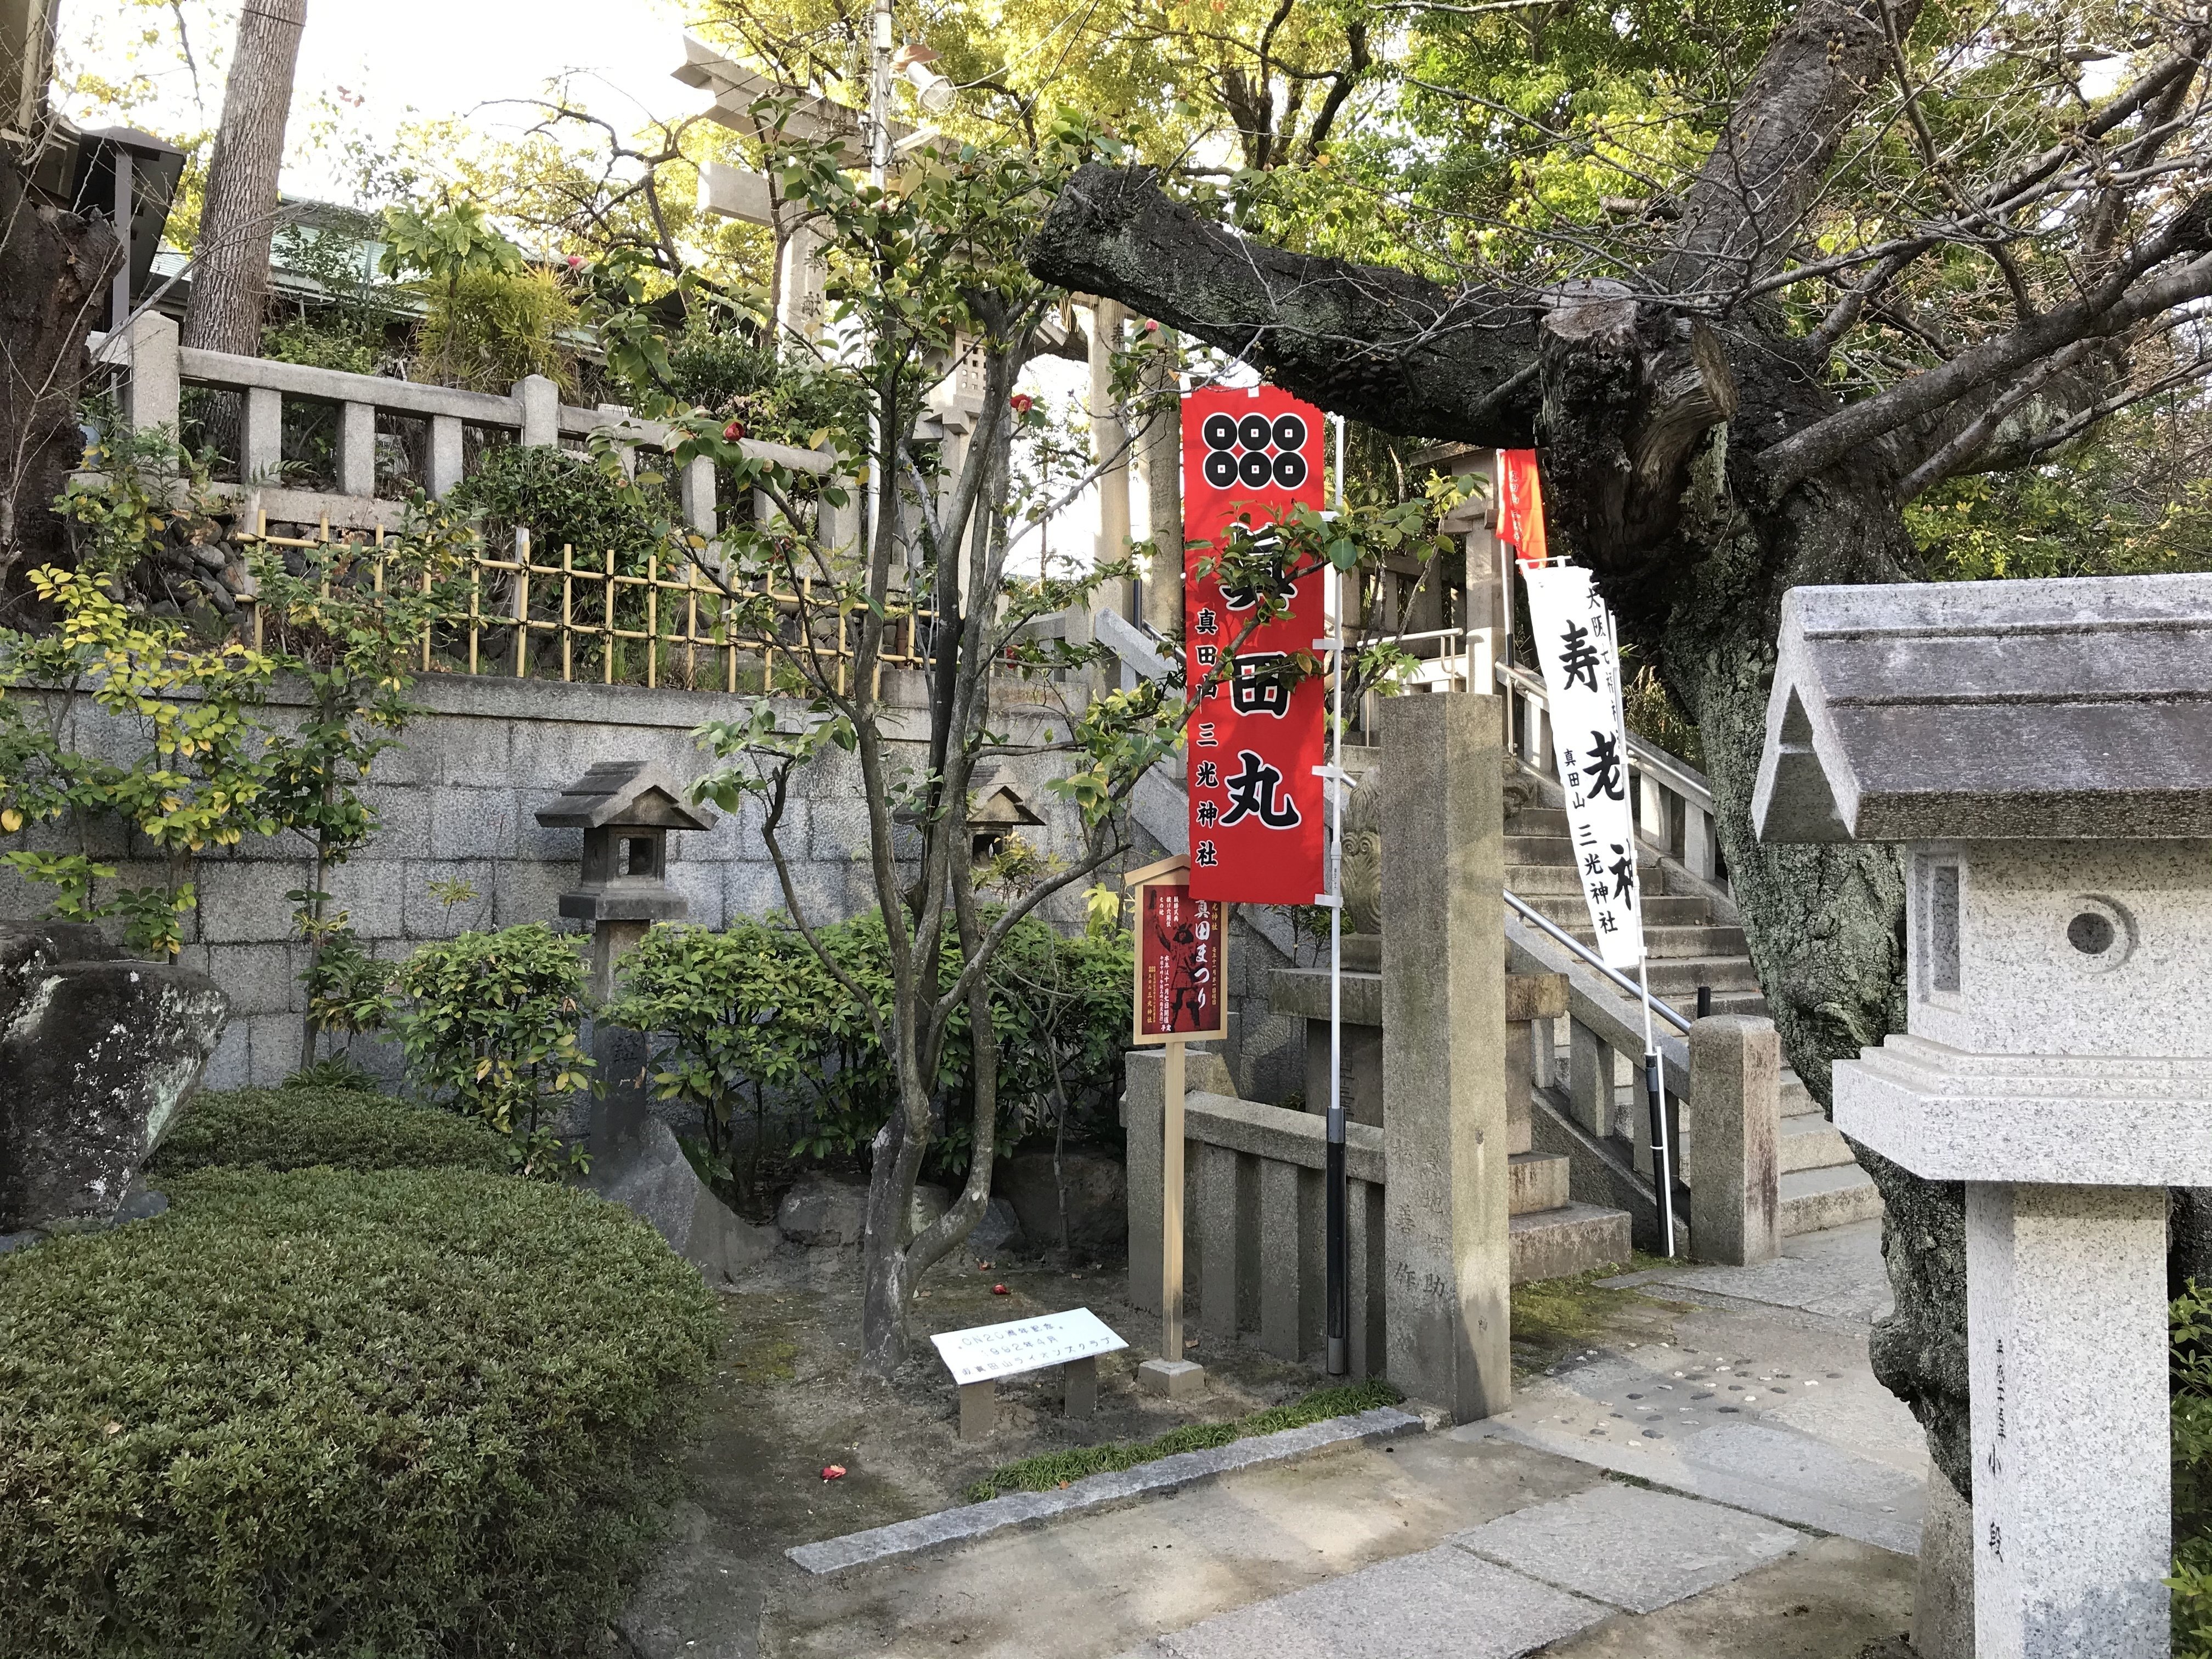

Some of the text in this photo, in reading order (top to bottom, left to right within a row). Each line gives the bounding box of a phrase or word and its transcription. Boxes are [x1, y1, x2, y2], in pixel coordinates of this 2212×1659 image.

[1194, 608, 1219, 868] 真田山三光神社
[1563, 748, 1618, 934] 真田山三光神社
[1194, 899, 1211, 1010] 真田まつり
